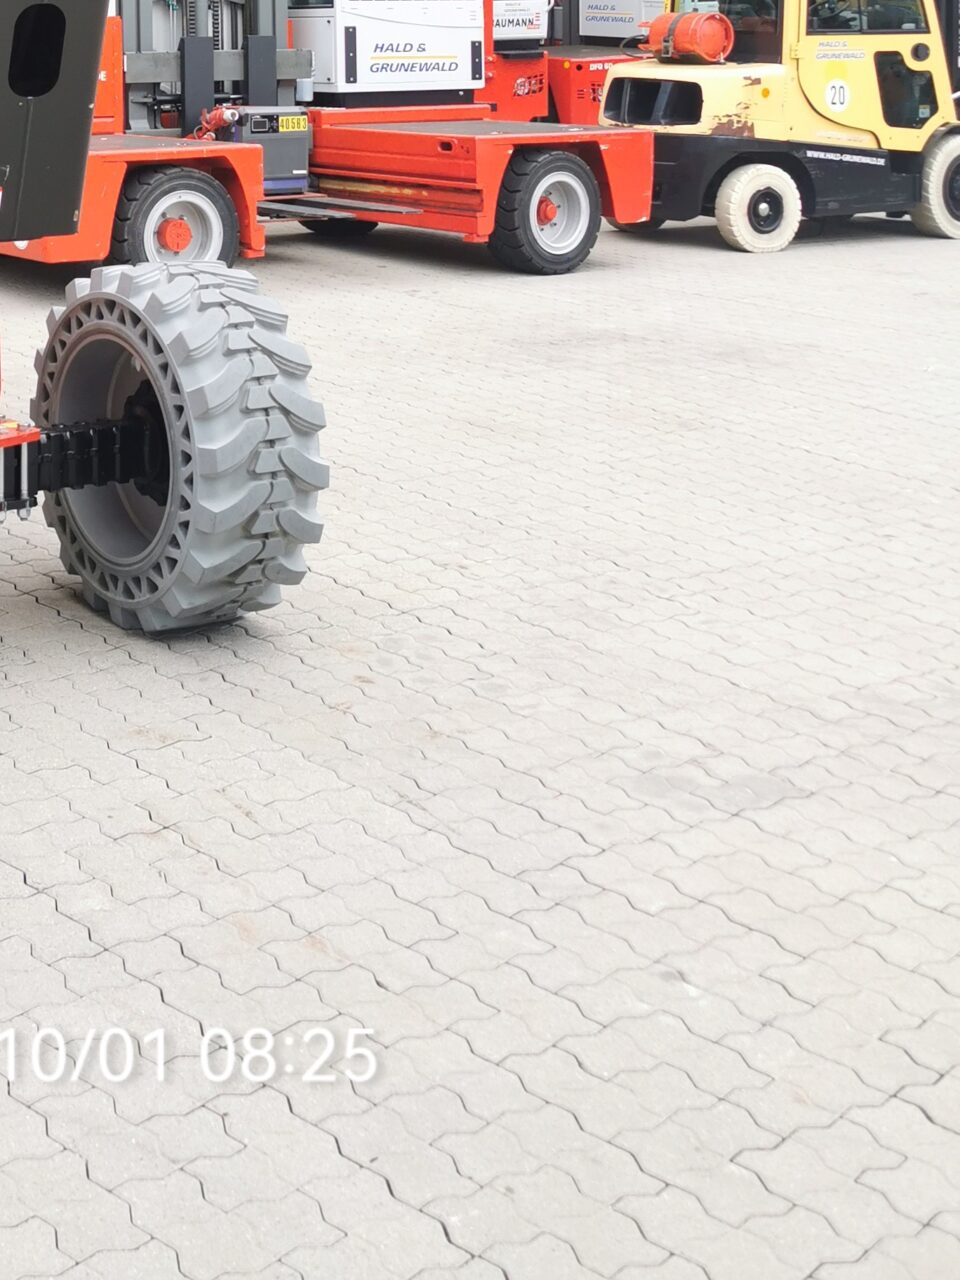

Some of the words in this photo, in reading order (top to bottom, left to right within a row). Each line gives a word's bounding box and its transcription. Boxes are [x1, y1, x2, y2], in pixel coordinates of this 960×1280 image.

[493, 18, 534, 28] AUMANN
[585, 15, 634, 23] GRUNEWALD
[373, 43, 413, 53] HALD
[370, 62, 459, 73] GRUNEWALD
[830, 85, 845, 105] 20
